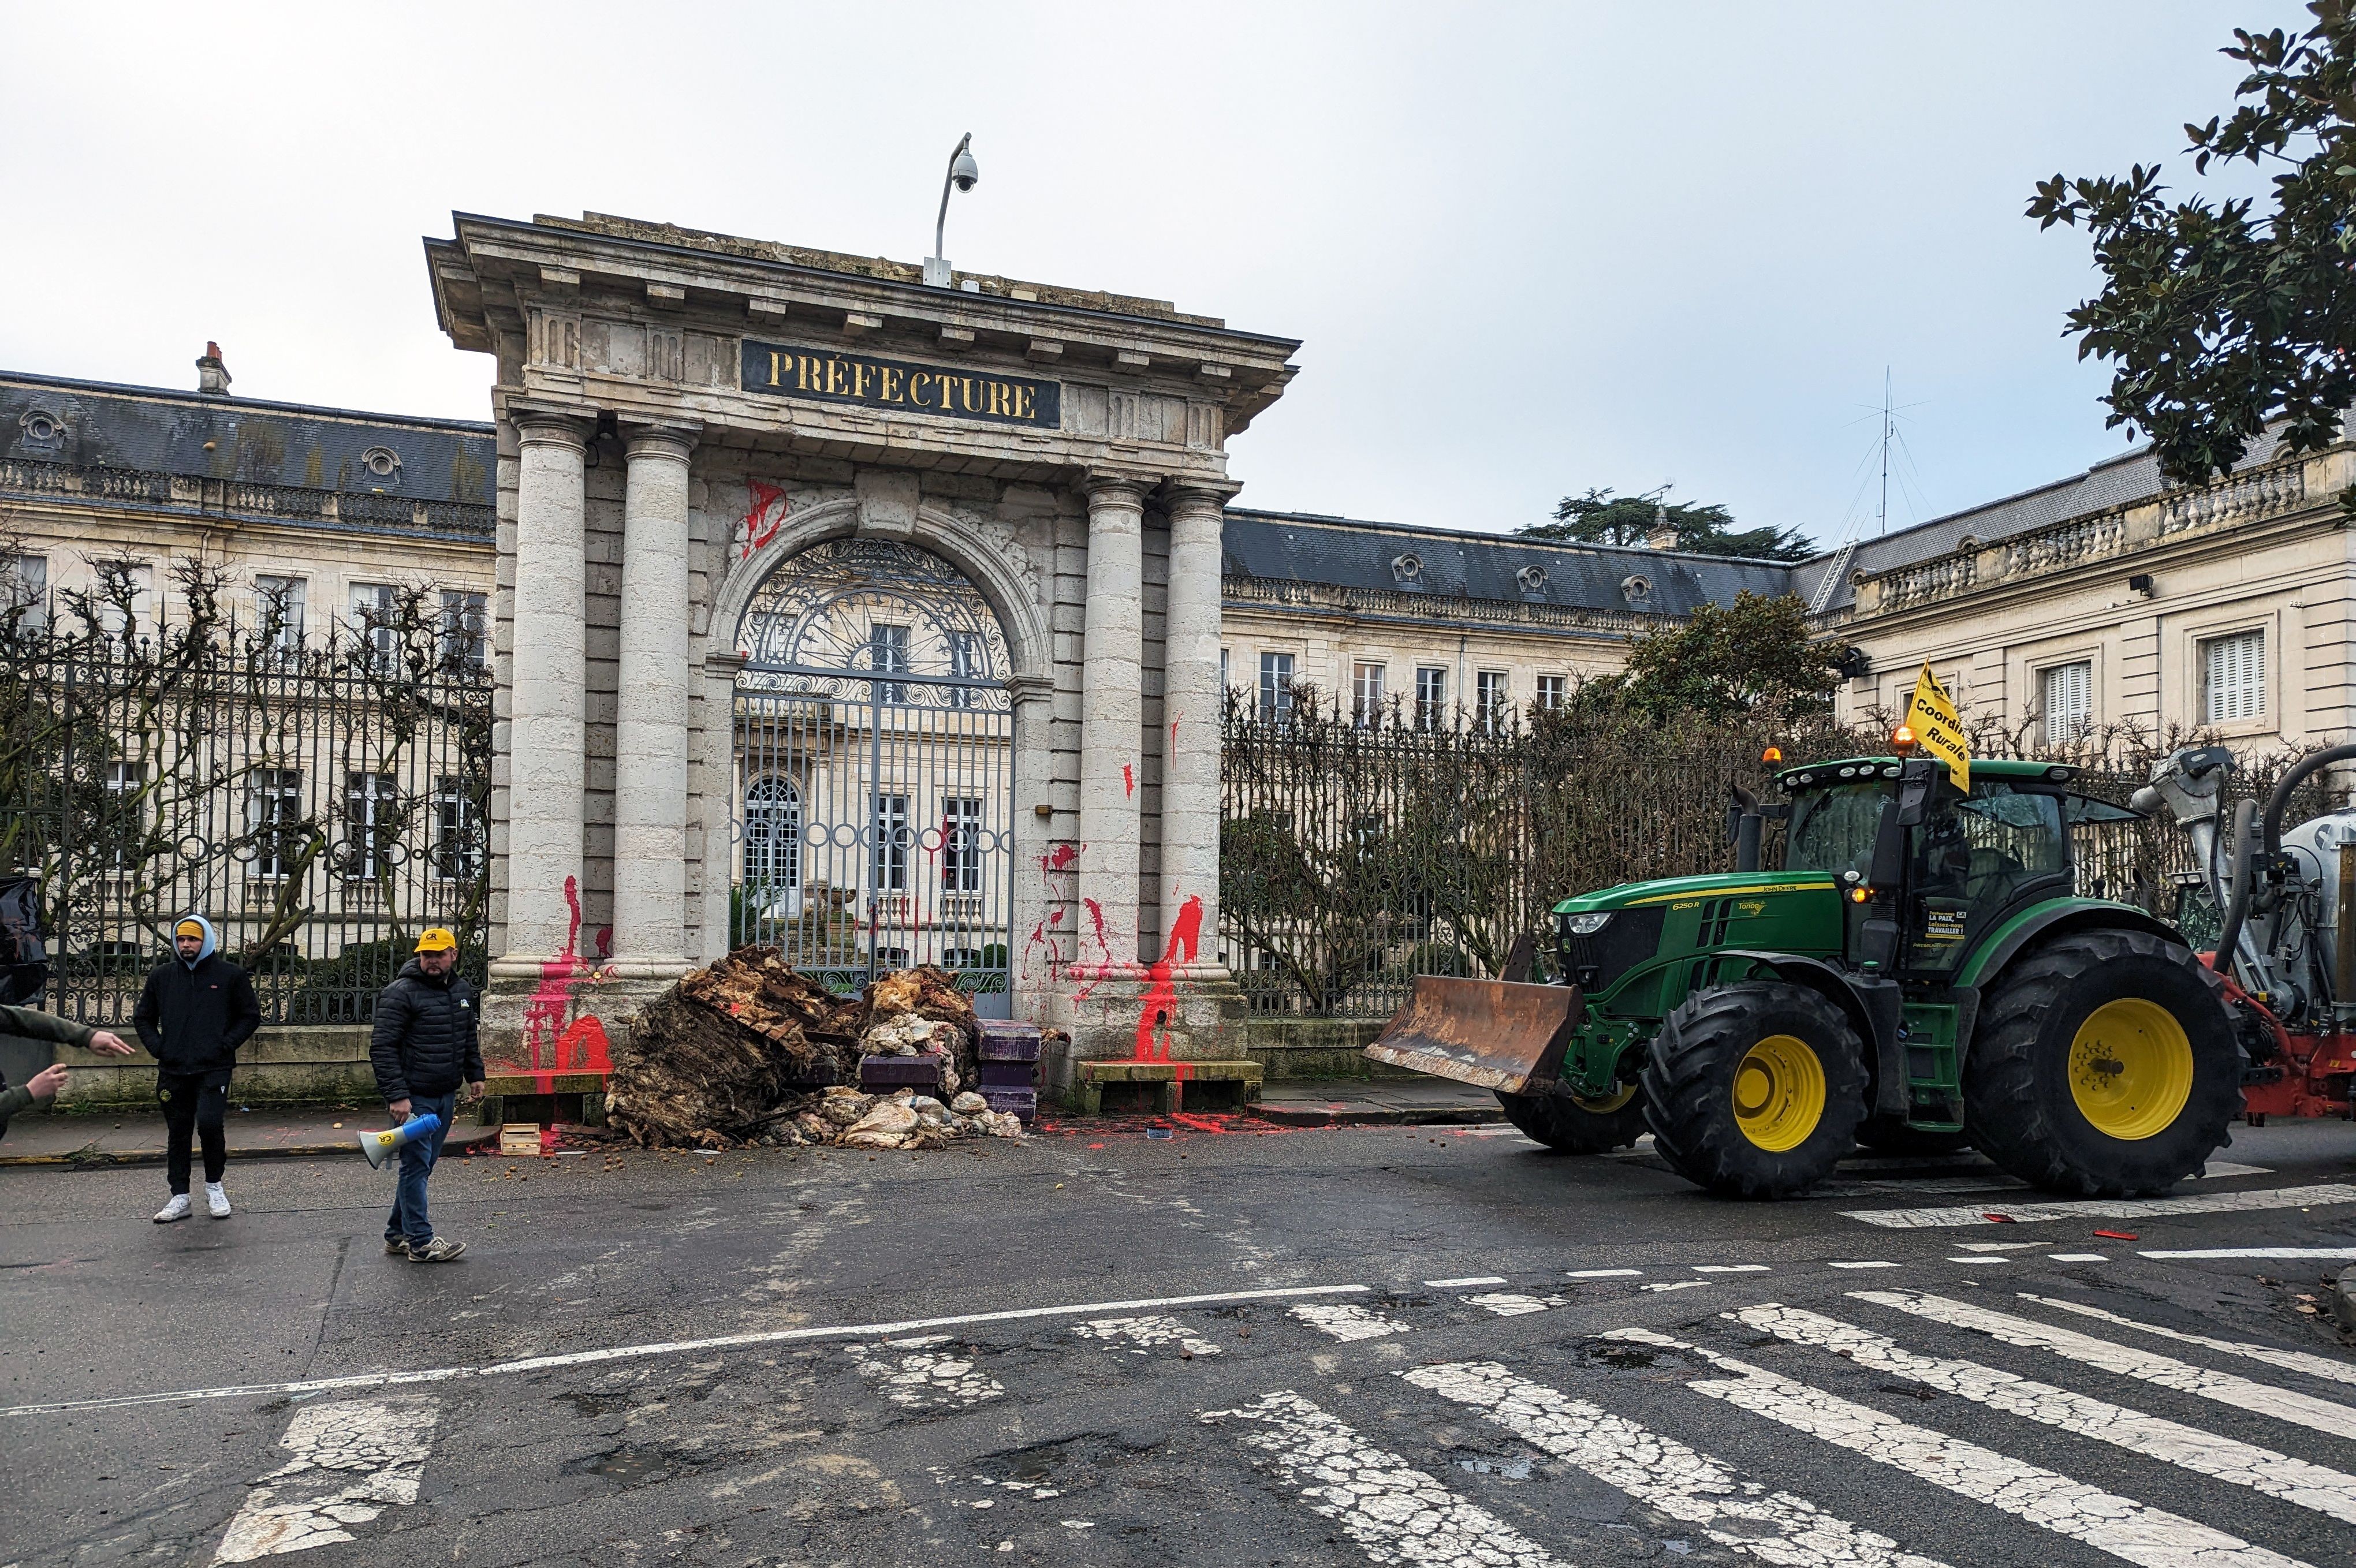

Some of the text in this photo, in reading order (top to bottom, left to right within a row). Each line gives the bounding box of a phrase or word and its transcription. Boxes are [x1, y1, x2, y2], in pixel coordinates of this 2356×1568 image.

[766, 351, 1035, 419] PRÉFECTURE
[1926, 727, 1965, 761] Rurale
[1672, 902, 1693, 910] 6250
